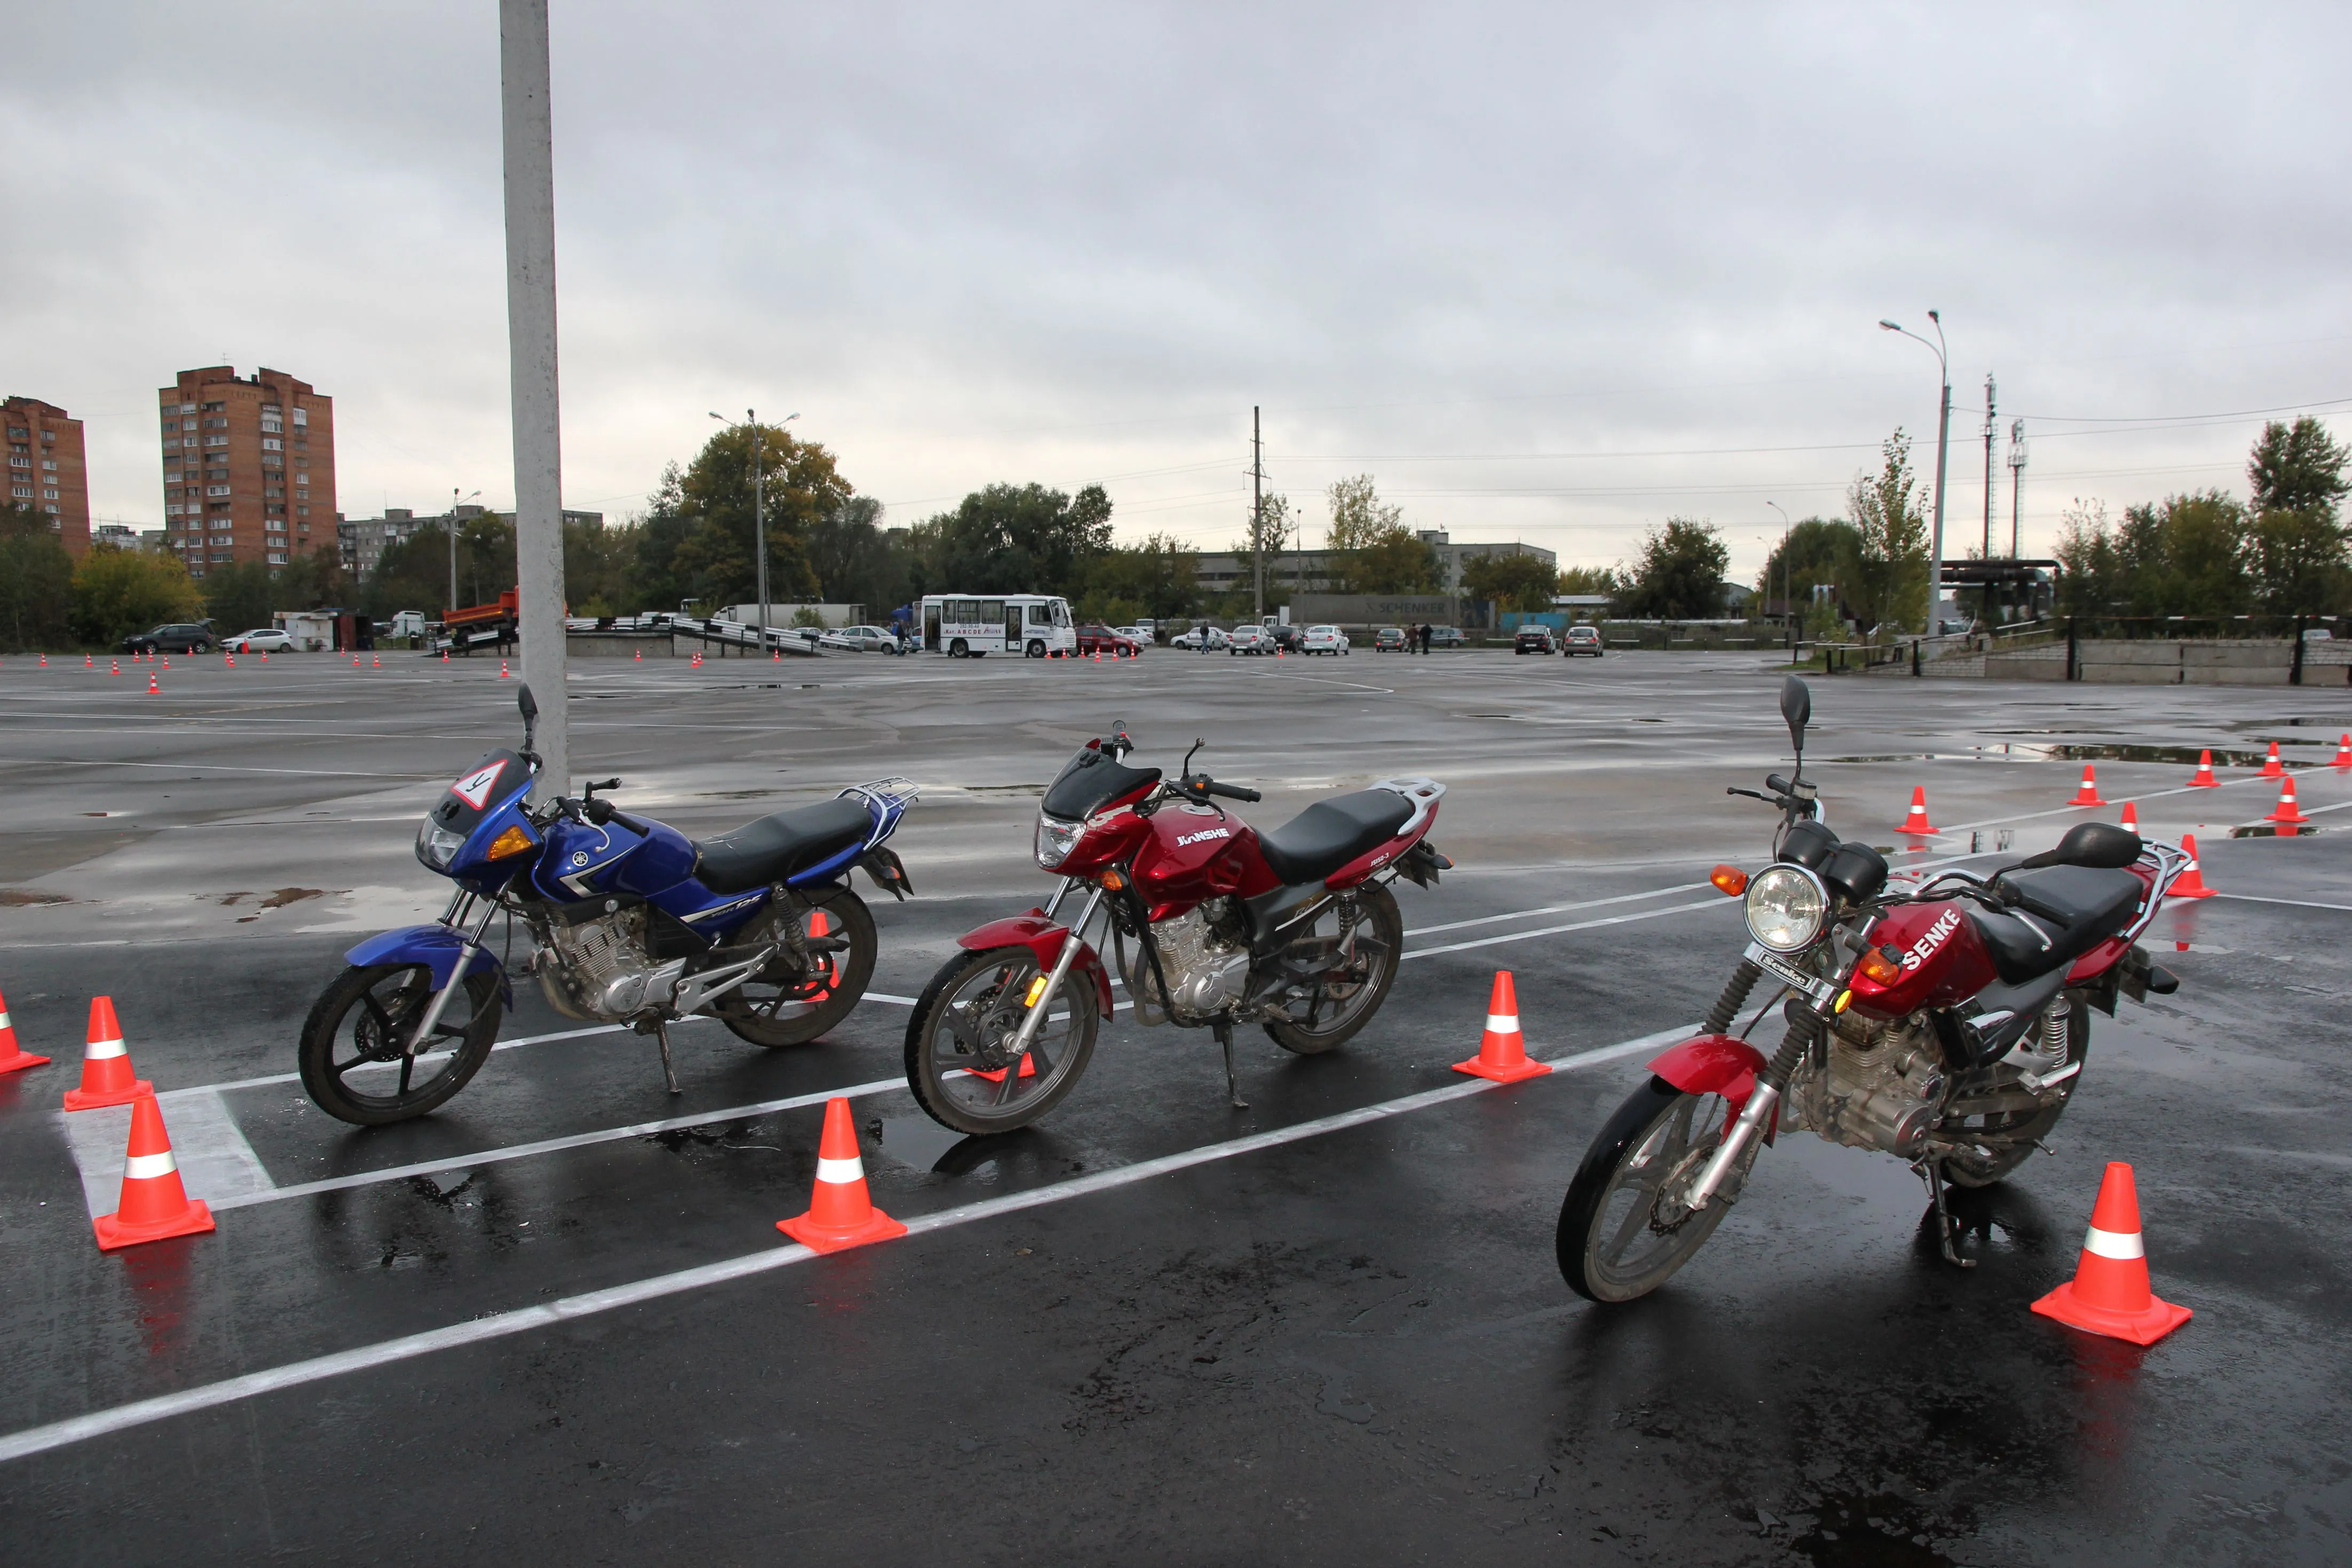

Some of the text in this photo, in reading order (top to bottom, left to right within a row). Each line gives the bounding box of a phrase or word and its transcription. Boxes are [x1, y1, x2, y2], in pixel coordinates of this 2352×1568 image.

[1379, 602, 1445, 613] SCHENKER
[1177, 827, 1230, 847] JIANSHE
[1370, 852, 1390, 867] JS150-3
[1902, 908, 1960, 970] SENKE
[1762, 956, 1805, 985] Senke
